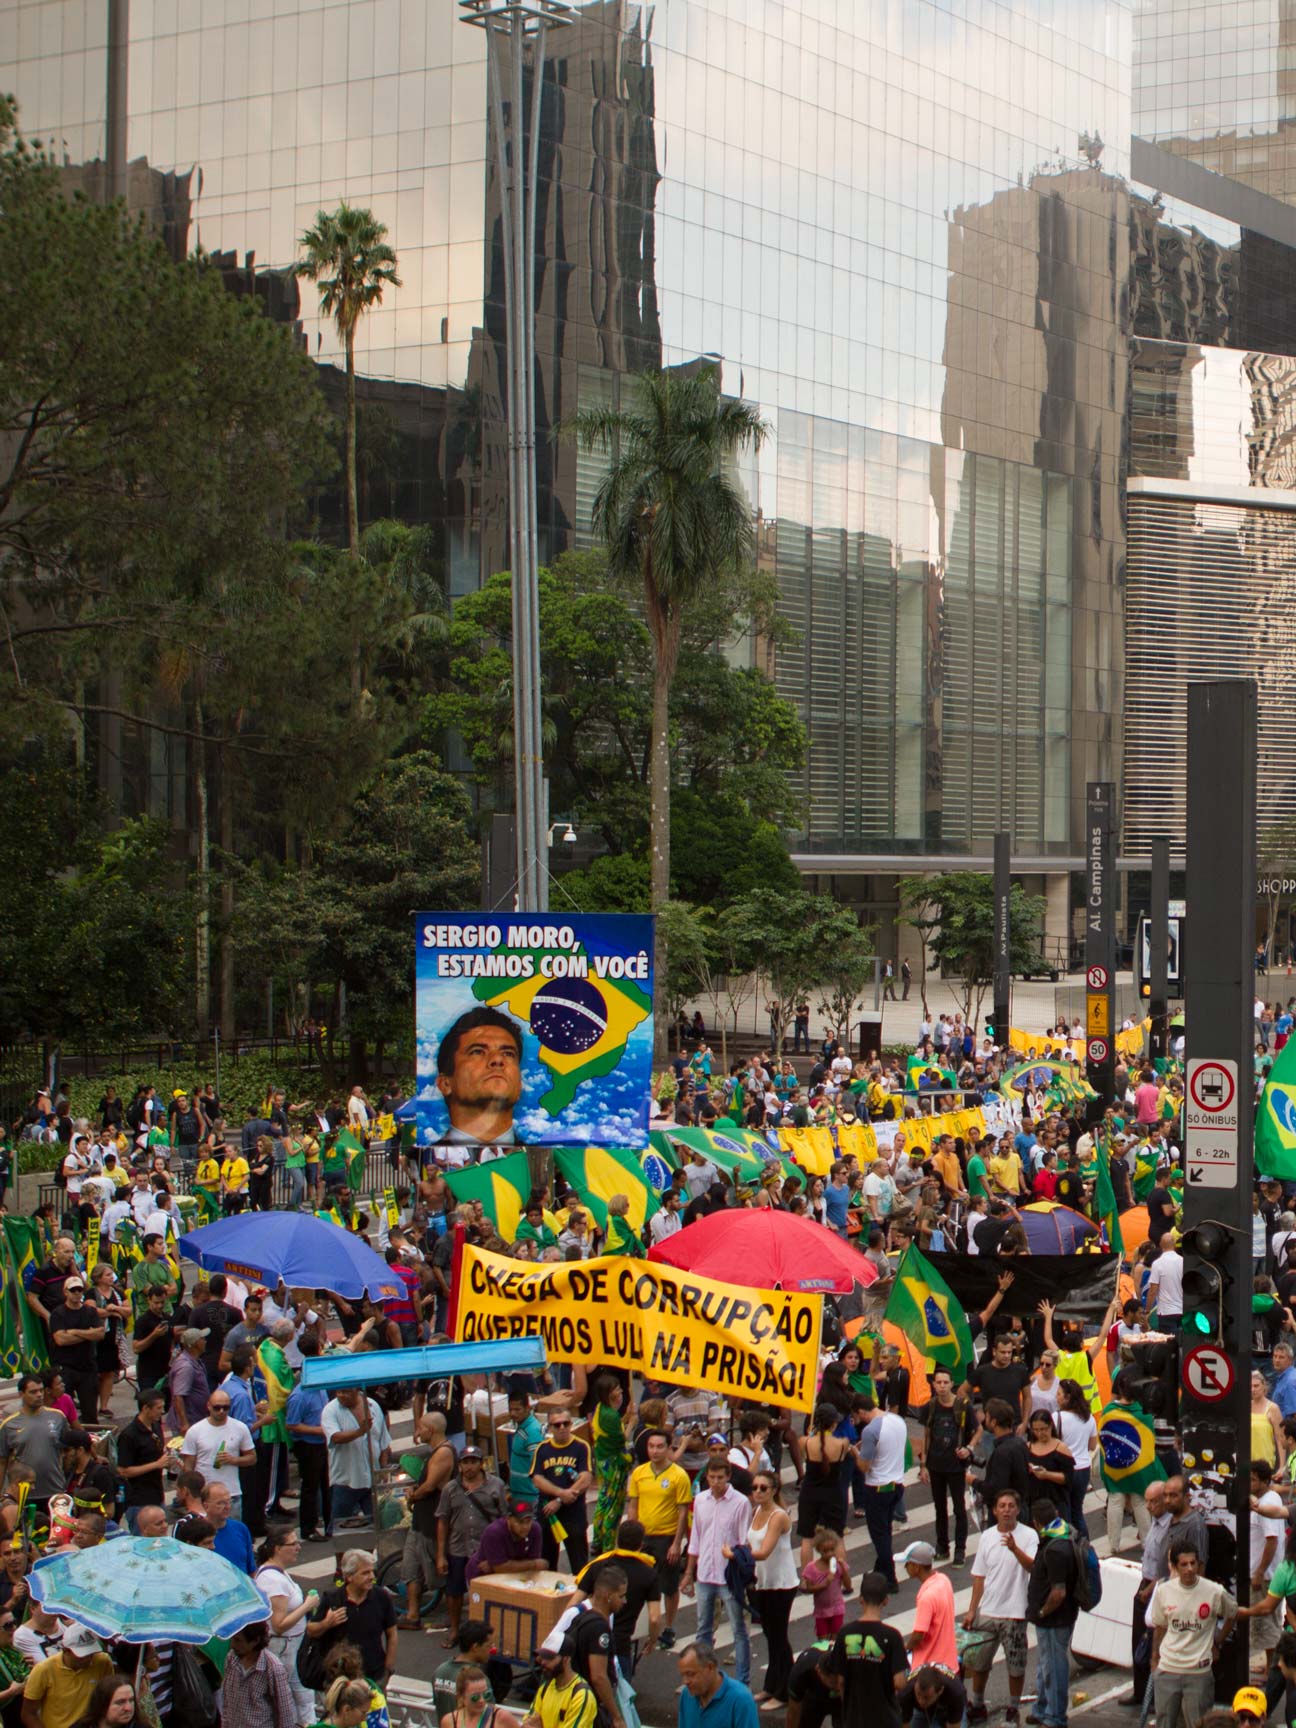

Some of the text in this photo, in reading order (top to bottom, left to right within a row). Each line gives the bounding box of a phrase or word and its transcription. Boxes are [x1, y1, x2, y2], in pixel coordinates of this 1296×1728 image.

[1090, 827, 1104, 906] Campinas
[1000, 895, 1008, 941] Paulista
[1090, 909, 1102, 932] Al.
[423, 924, 581, 953] SERGIO MORO,
[438, 950, 649, 979] ESTAMOS COM VOCÊ
[1091, 1044, 1105, 1055] 50
[1187, 1113, 1236, 1125] SÓ ÔNIBUS
[1196, 1148, 1202, 1157] 6
[1213, 1149, 1230, 1159] 22h
[470, 1259, 814, 1345] CHEGA DE CORRUPÇÃO
[463, 1310, 593, 1355] QUEREMOS
[650, 1331, 692, 1376] NA
[701, 1341, 806, 1401] PRISÃO!
[543, 1456, 577, 1471] BRASIL
